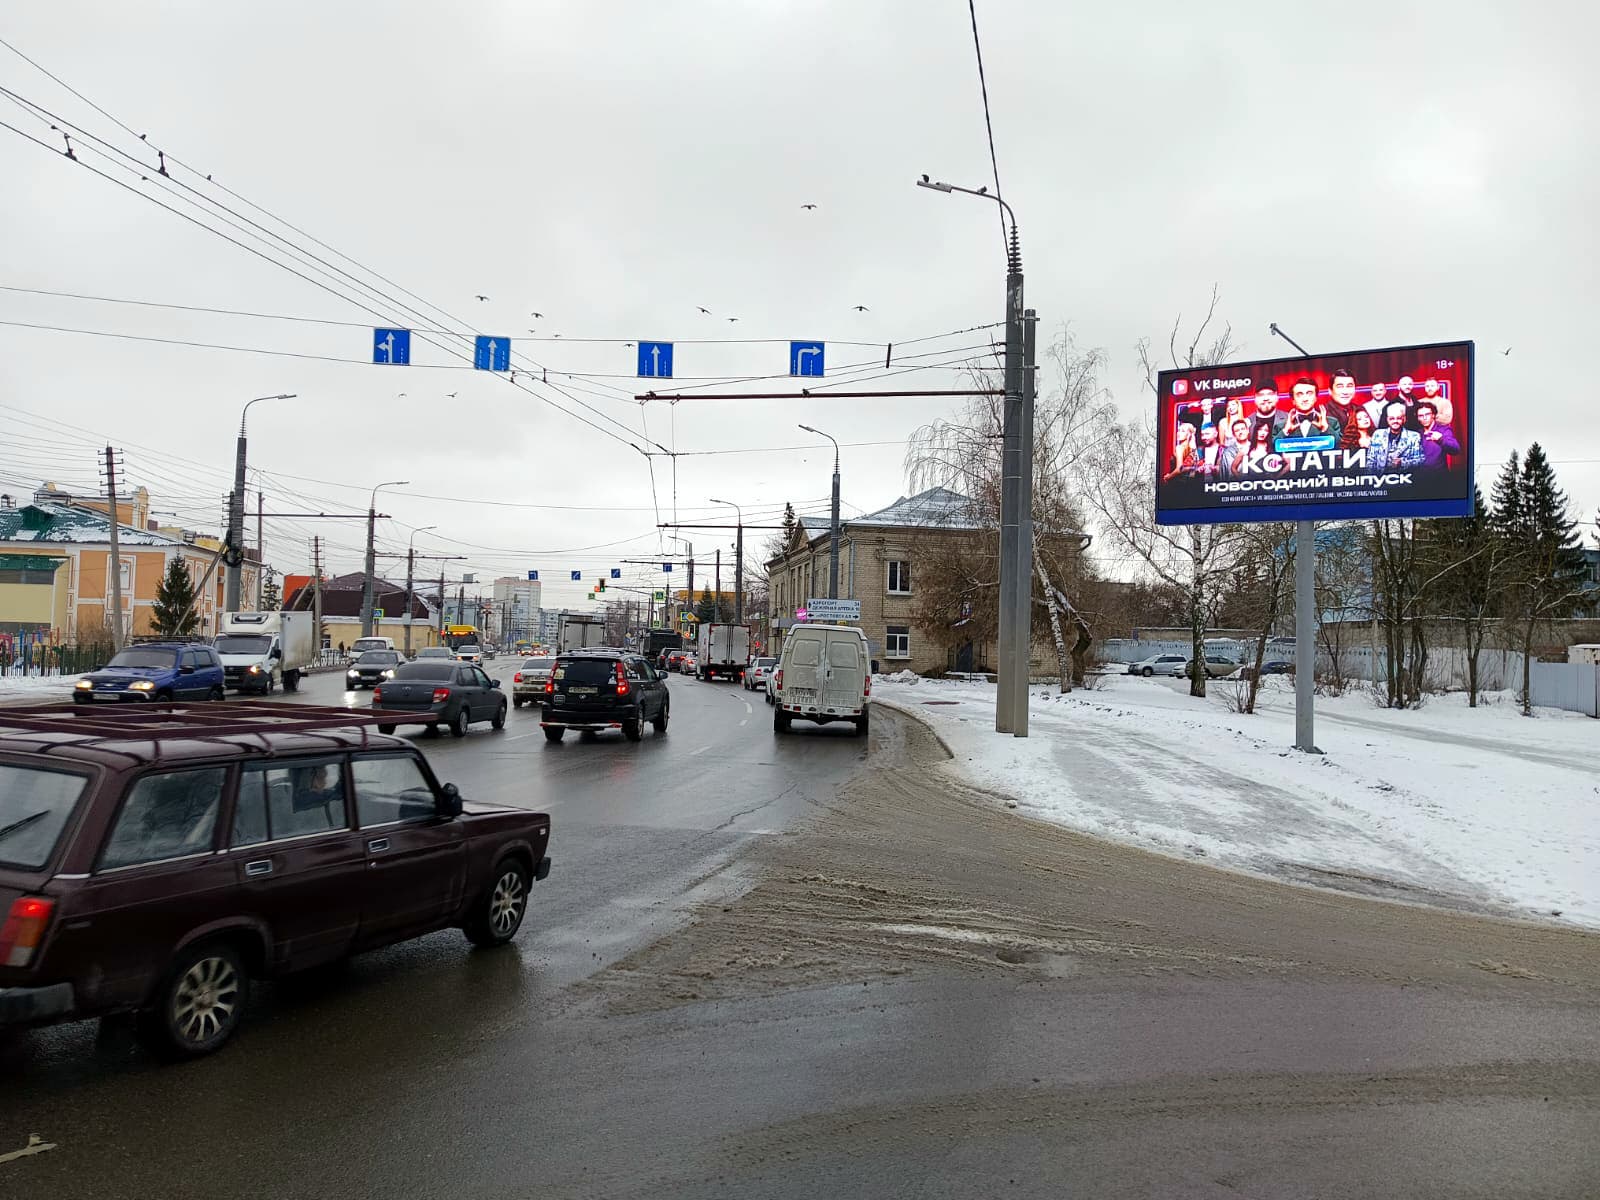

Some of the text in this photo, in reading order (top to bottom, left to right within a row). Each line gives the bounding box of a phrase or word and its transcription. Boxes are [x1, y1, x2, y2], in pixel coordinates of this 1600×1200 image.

[1436, 360, 1454, 369] 18+
[1194, 378, 1252, 391] VK Видео
[1241, 449, 1366, 474] КСТАТИ
[1204, 474, 1413, 492] НОВОГОДНИЙ ВЫПУСК
